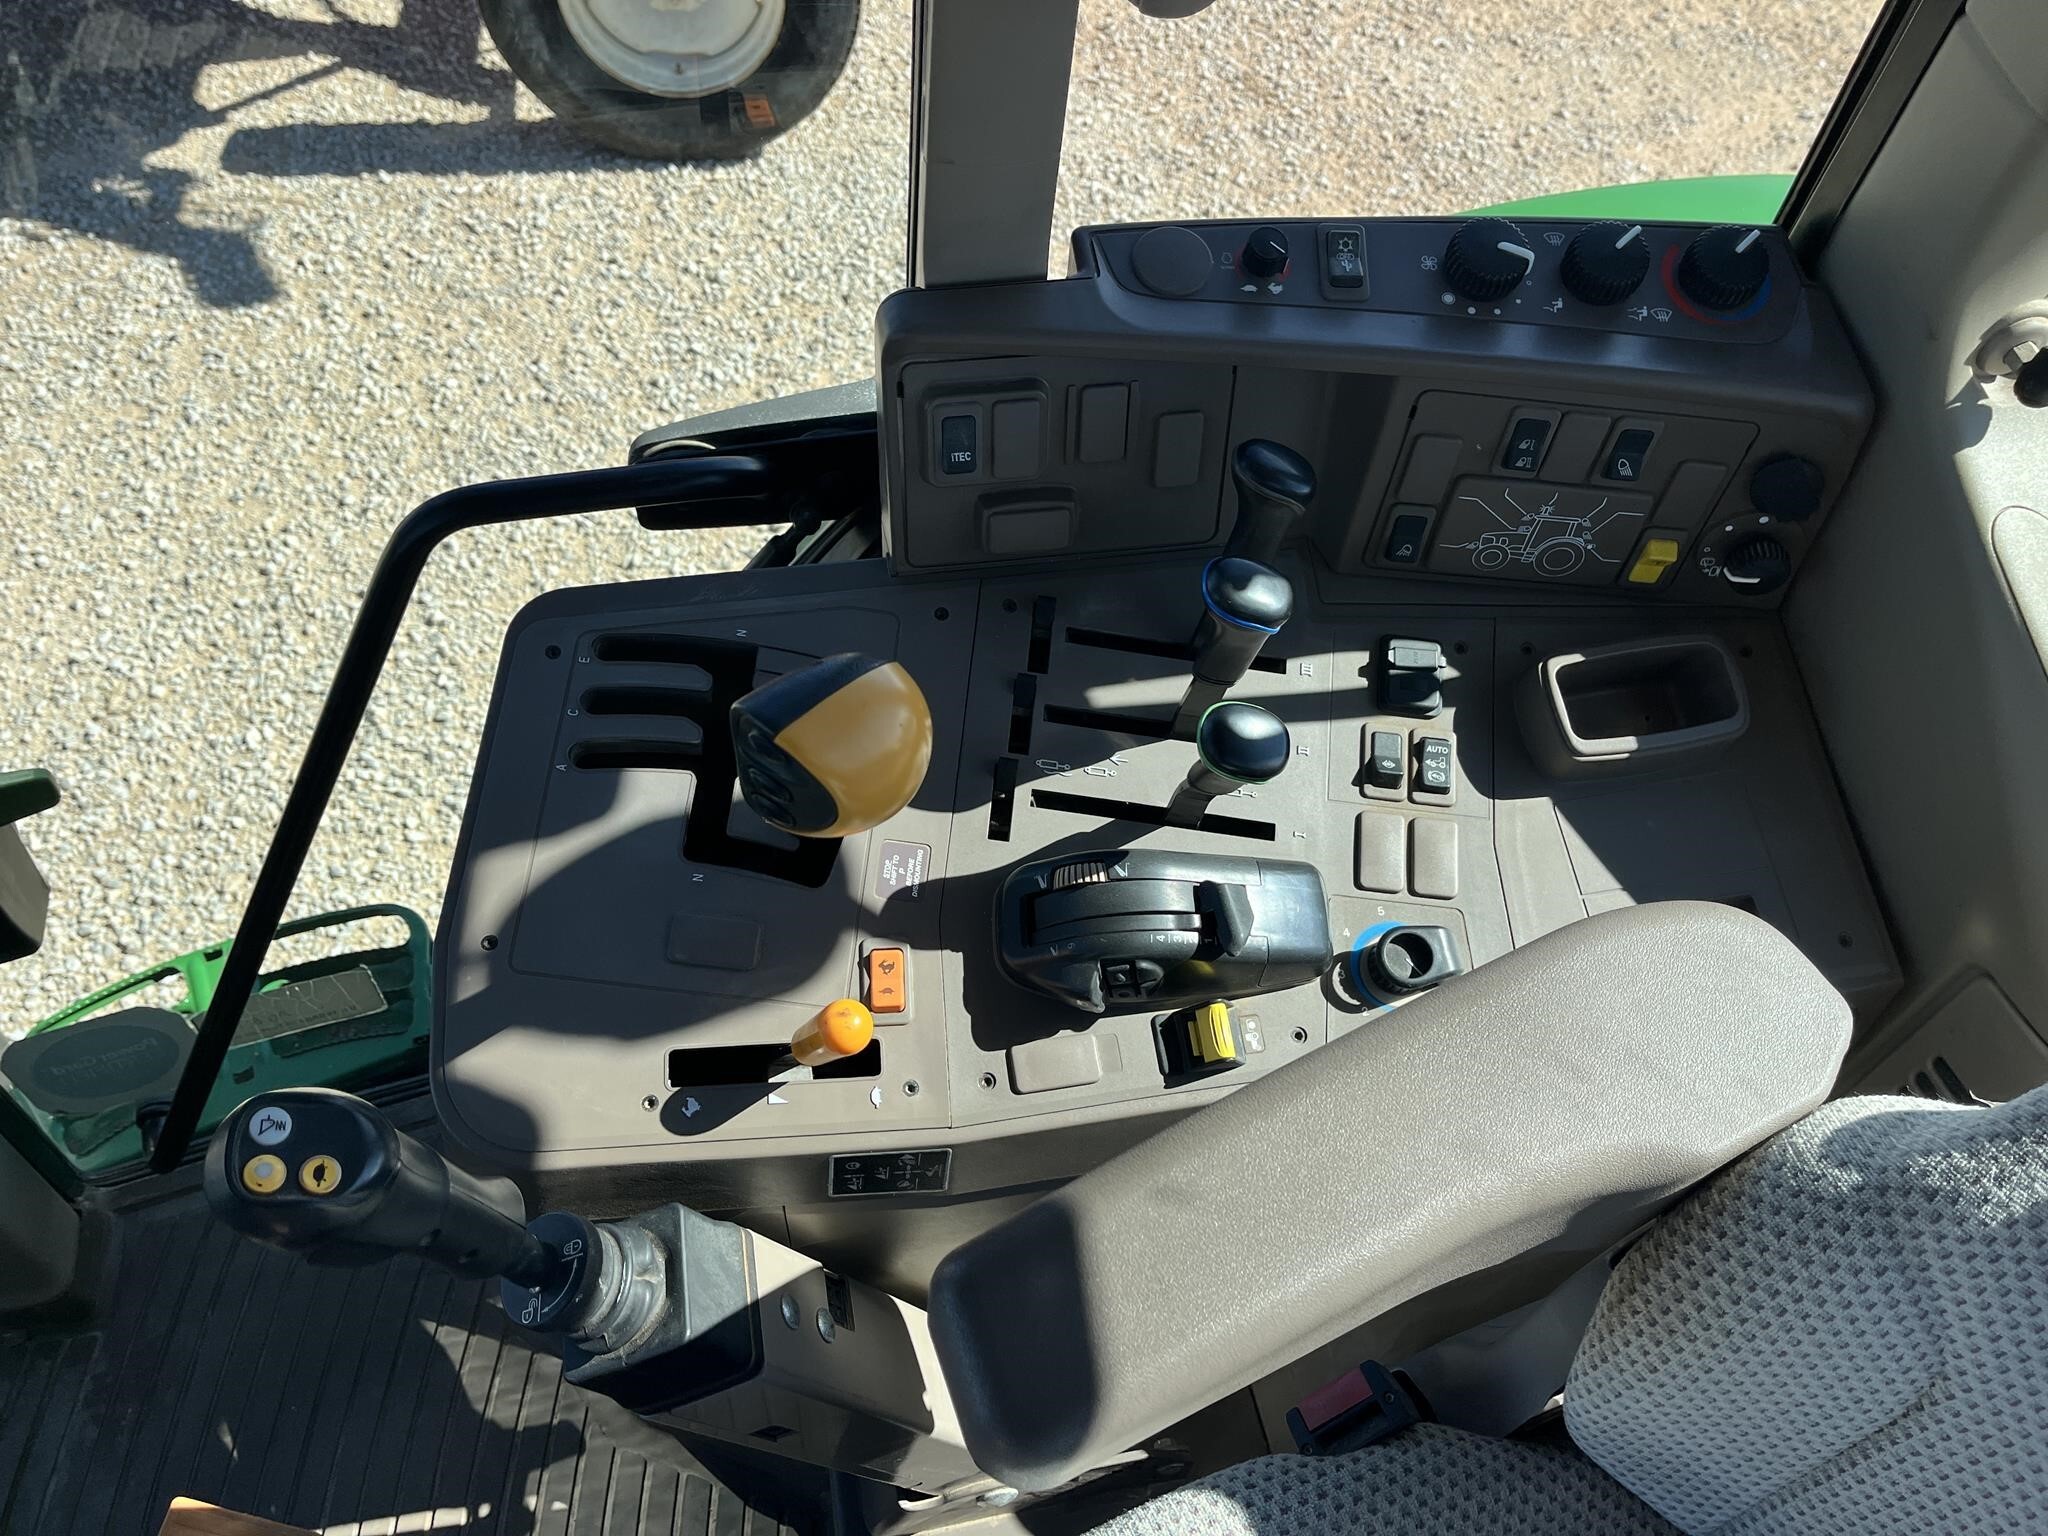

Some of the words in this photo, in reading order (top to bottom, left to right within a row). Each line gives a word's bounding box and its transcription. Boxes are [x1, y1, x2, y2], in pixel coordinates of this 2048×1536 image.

[736, 629, 747, 637] N
[578, 656, 590, 664] E
[567, 708, 579, 717] C
[1426, 744, 1449, 754] AUTO
[555, 764, 568, 772] A
[892, 854, 900, 865] TO
[882, 859, 892, 879] STOP
[898, 867, 906, 875] P
[905, 857, 915, 886] BEFORE
[911, 849, 924, 897] DISMOUNTING
[691, 873, 704, 882] N
[889, 864, 899, 886] SHIFT
[1377, 906, 1385, 916] 5
[1343, 928, 1351, 937] 4
[1155, 934, 1166, 942] 4
[1173, 935, 1182, 943] 3
[1339, 969, 1346, 979] 3
[1361, 1006, 1370, 1017] 2
